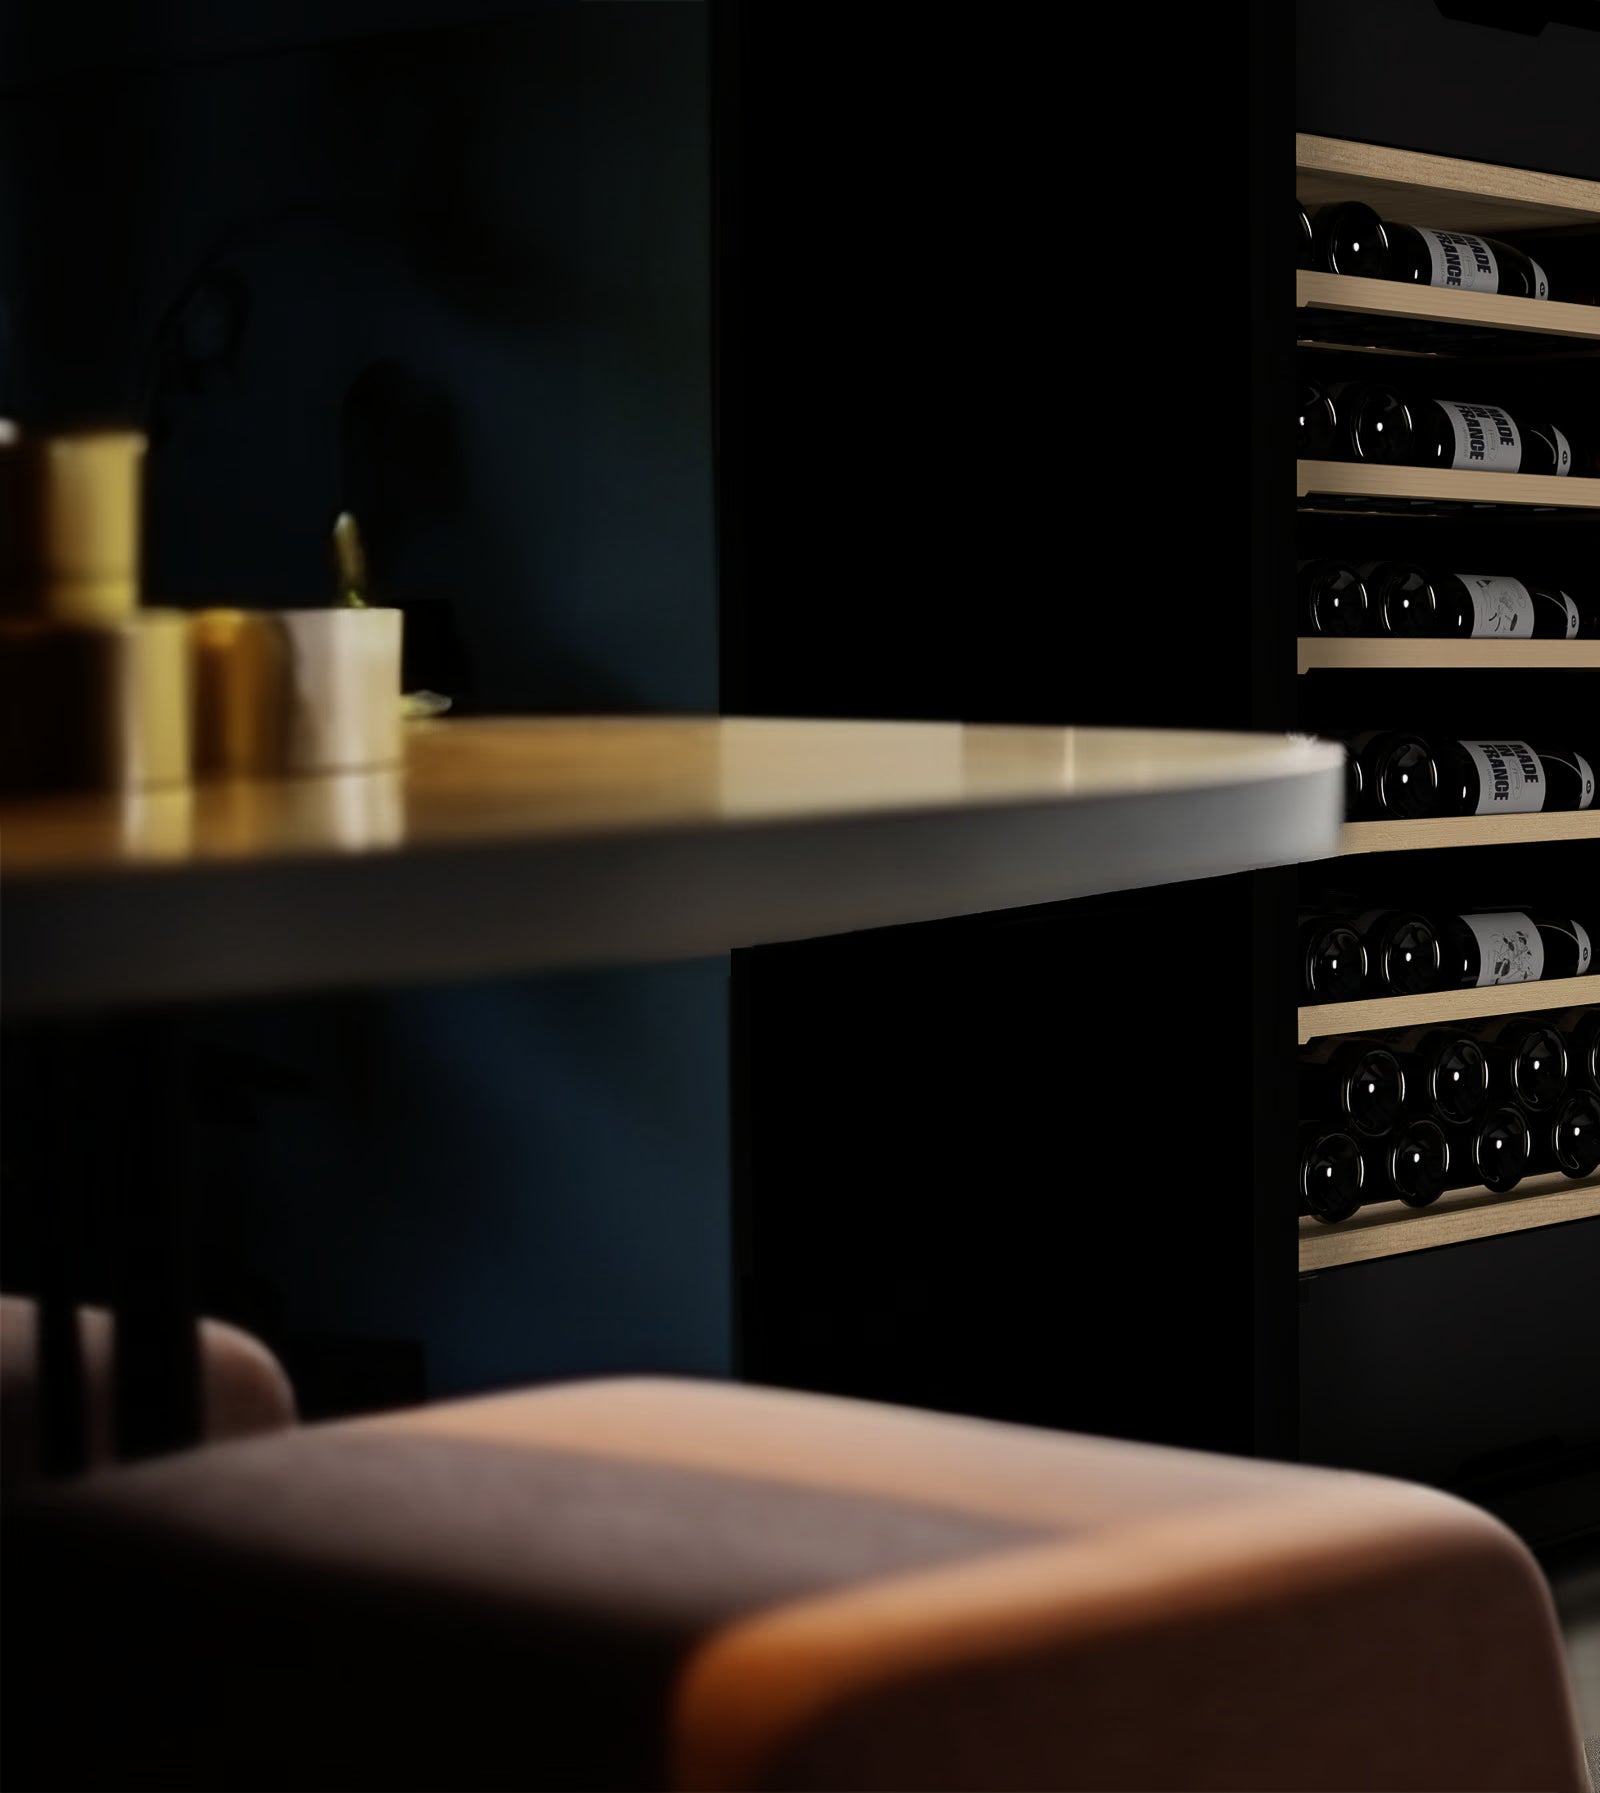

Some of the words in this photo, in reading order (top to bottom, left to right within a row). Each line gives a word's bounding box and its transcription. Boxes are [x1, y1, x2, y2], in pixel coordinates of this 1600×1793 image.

[1430, 230, 1462, 287] FRANCE
[1454, 404, 1485, 461] FRANCE
[1485, 407, 1514, 447] MADE
[1478, 744, 1510, 801] FRANCE
[1493, 744, 1515, 757] IN
[1508, 744, 1539, 783] MADE
